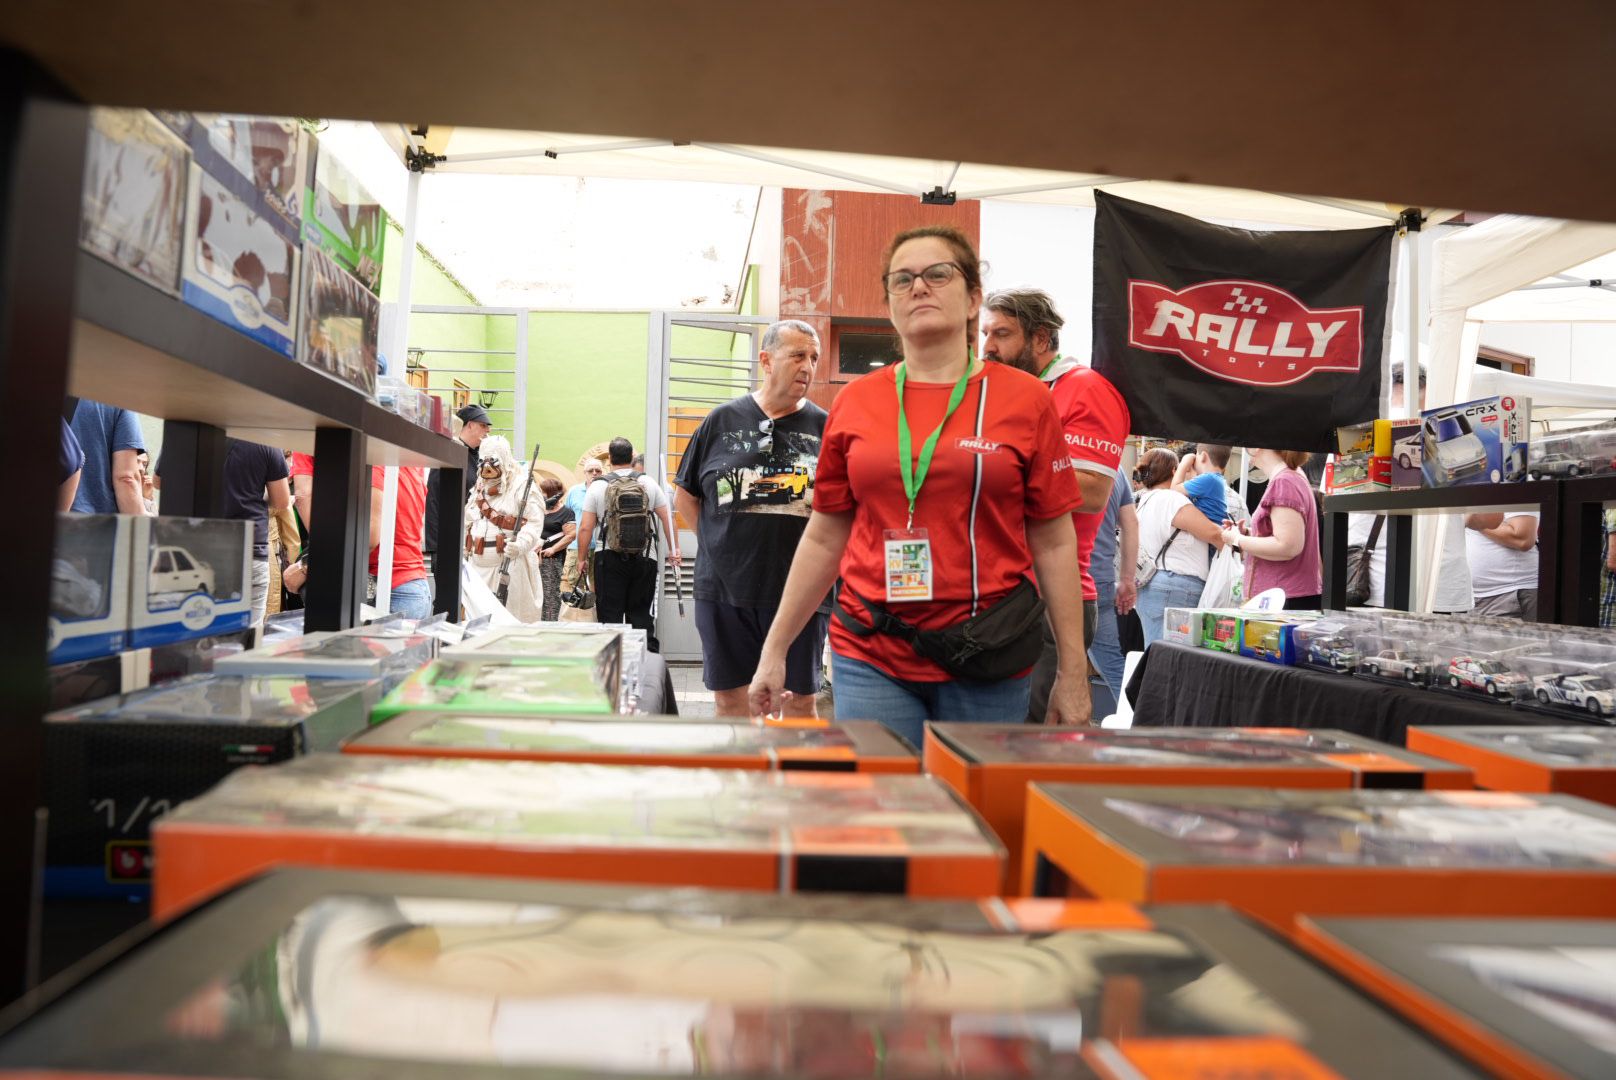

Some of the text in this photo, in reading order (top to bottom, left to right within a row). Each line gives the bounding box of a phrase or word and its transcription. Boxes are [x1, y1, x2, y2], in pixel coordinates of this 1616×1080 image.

[1143, 299, 1348, 358] RALLY
[1202, 349, 1297, 371] TOYS
[959, 439, 999, 451] RALLY
[1064, 433, 1123, 457] RALLYTOY
